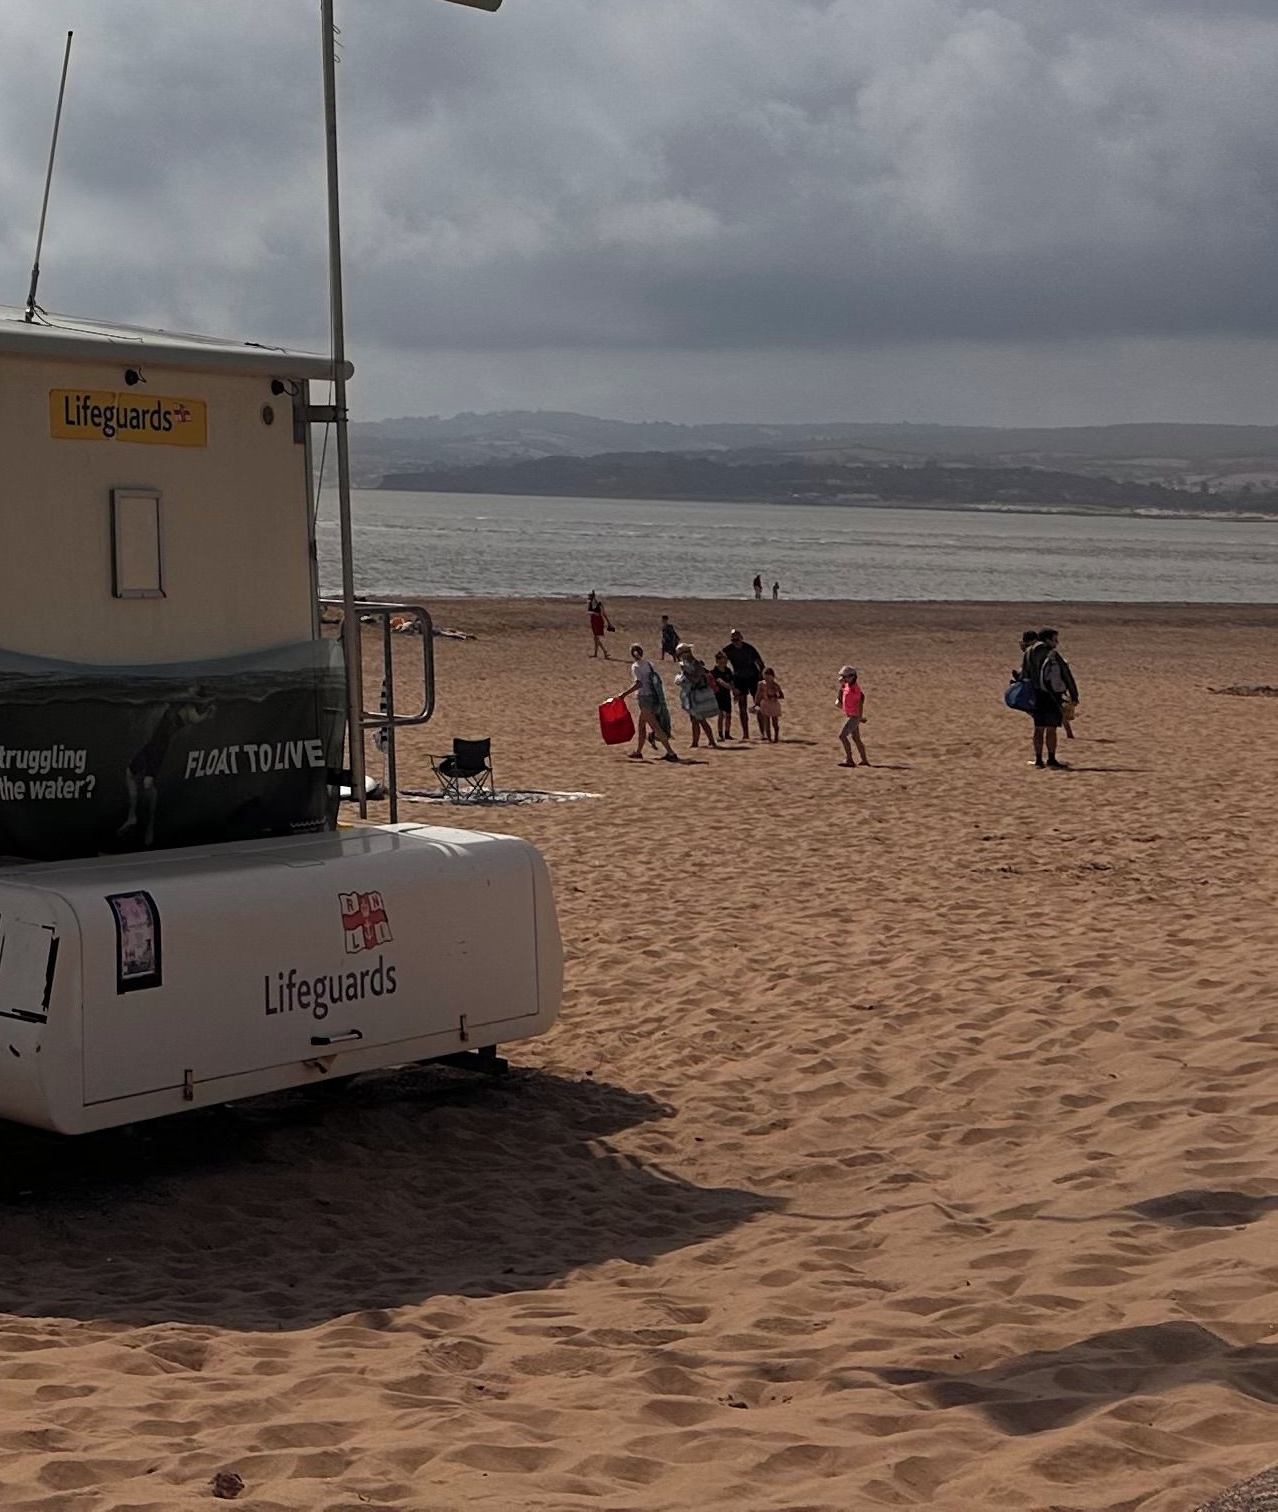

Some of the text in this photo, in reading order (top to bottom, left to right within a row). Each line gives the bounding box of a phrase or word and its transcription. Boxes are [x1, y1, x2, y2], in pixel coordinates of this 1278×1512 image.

[64, 395, 172, 437] Lifeguards
[184, 739, 325, 779] FLOAT TO LIVE
[0, 775, 26, 801] the
[29, 774, 96, 800] water?
[265, 955, 397, 1020] Lifeguards
